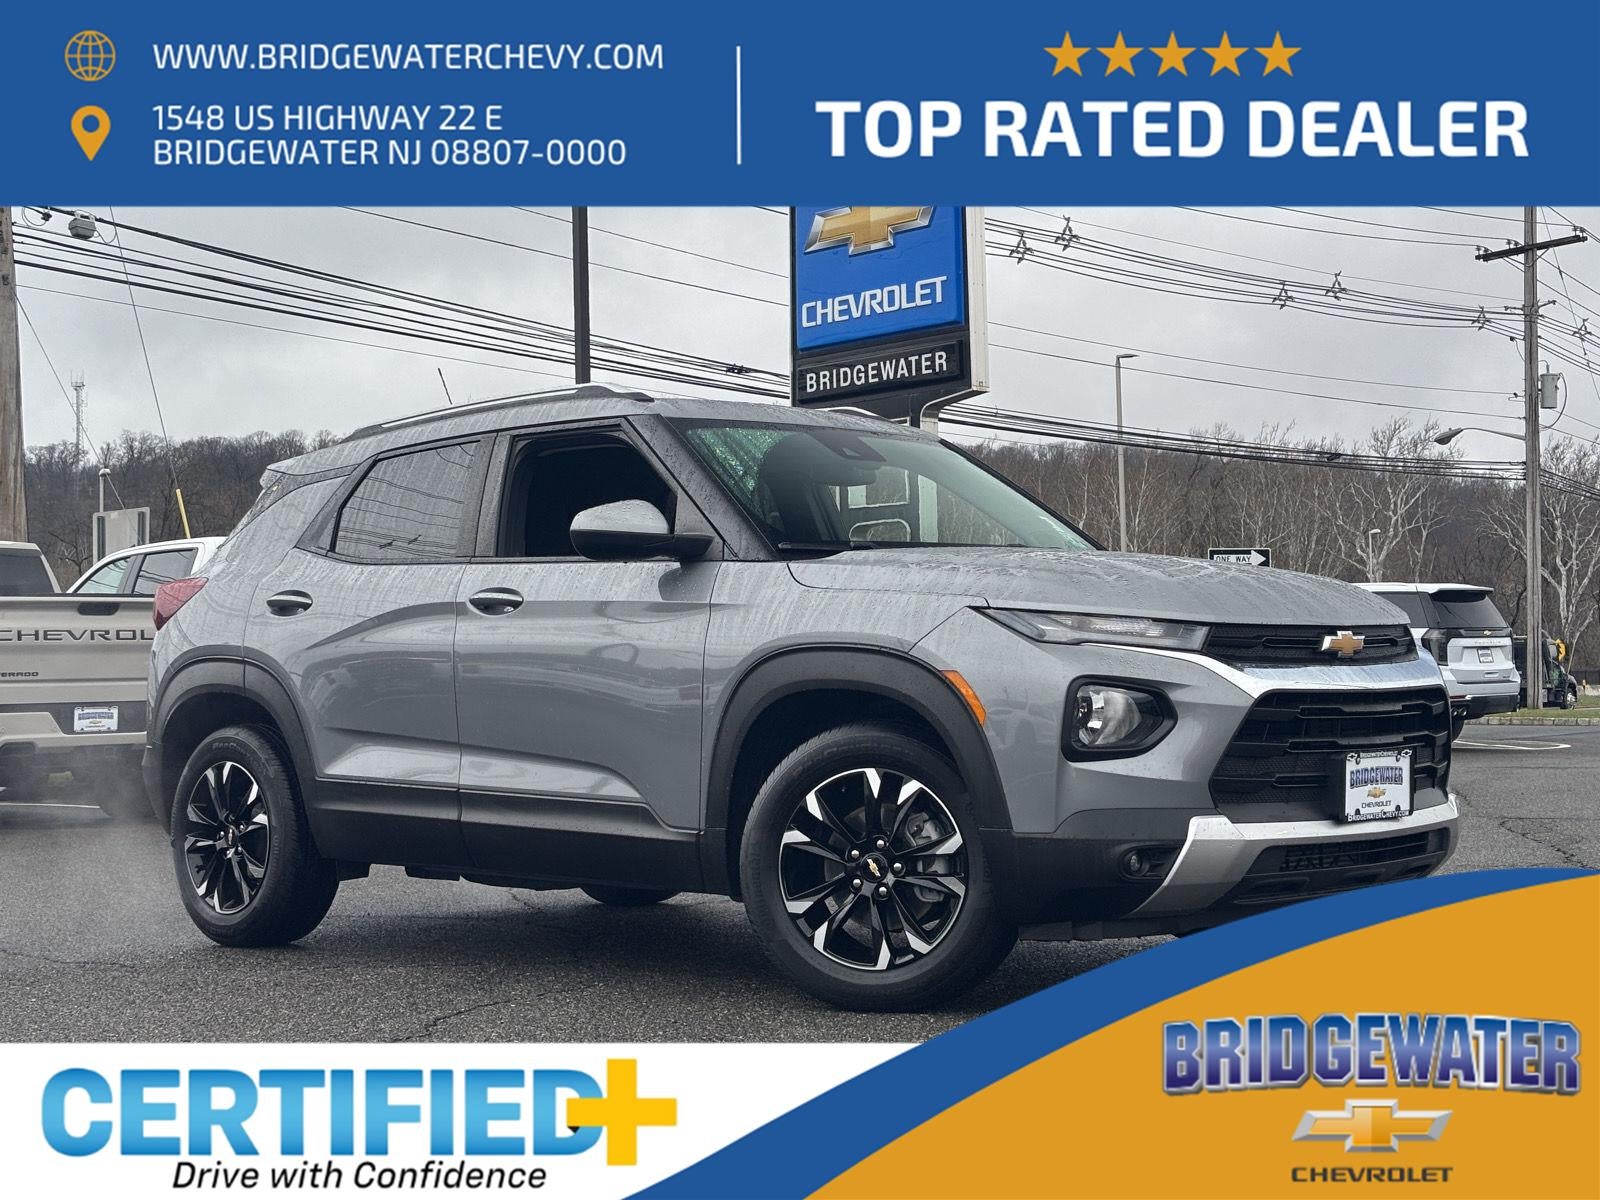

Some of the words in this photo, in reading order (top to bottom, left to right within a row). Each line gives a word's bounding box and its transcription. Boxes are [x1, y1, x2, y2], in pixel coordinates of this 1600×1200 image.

[801, 275, 947, 328] CHEVROLET
[806, 351, 948, 393] BRIDGEWATER
[1350, 766, 1403, 789] BRIDGEWATER
[1361, 800, 1391, 808] CHEVROLET
